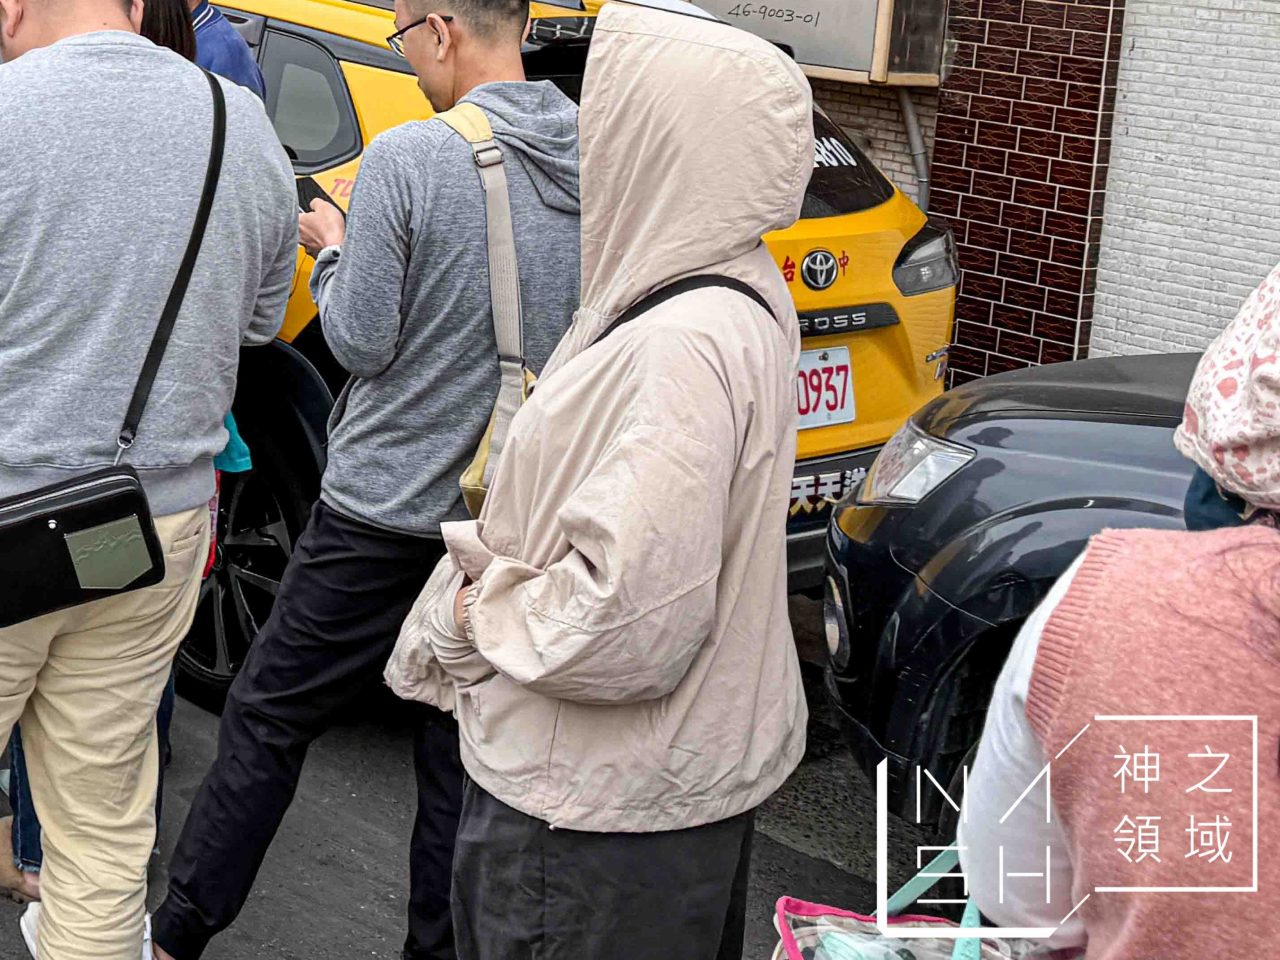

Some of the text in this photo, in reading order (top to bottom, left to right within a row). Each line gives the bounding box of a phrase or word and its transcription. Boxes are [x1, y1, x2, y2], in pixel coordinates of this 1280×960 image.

[727, 3, 820, 27] 46-9003-01
[782, 250, 850, 282] 台 中
[797, 365, 849, 415] 0937
